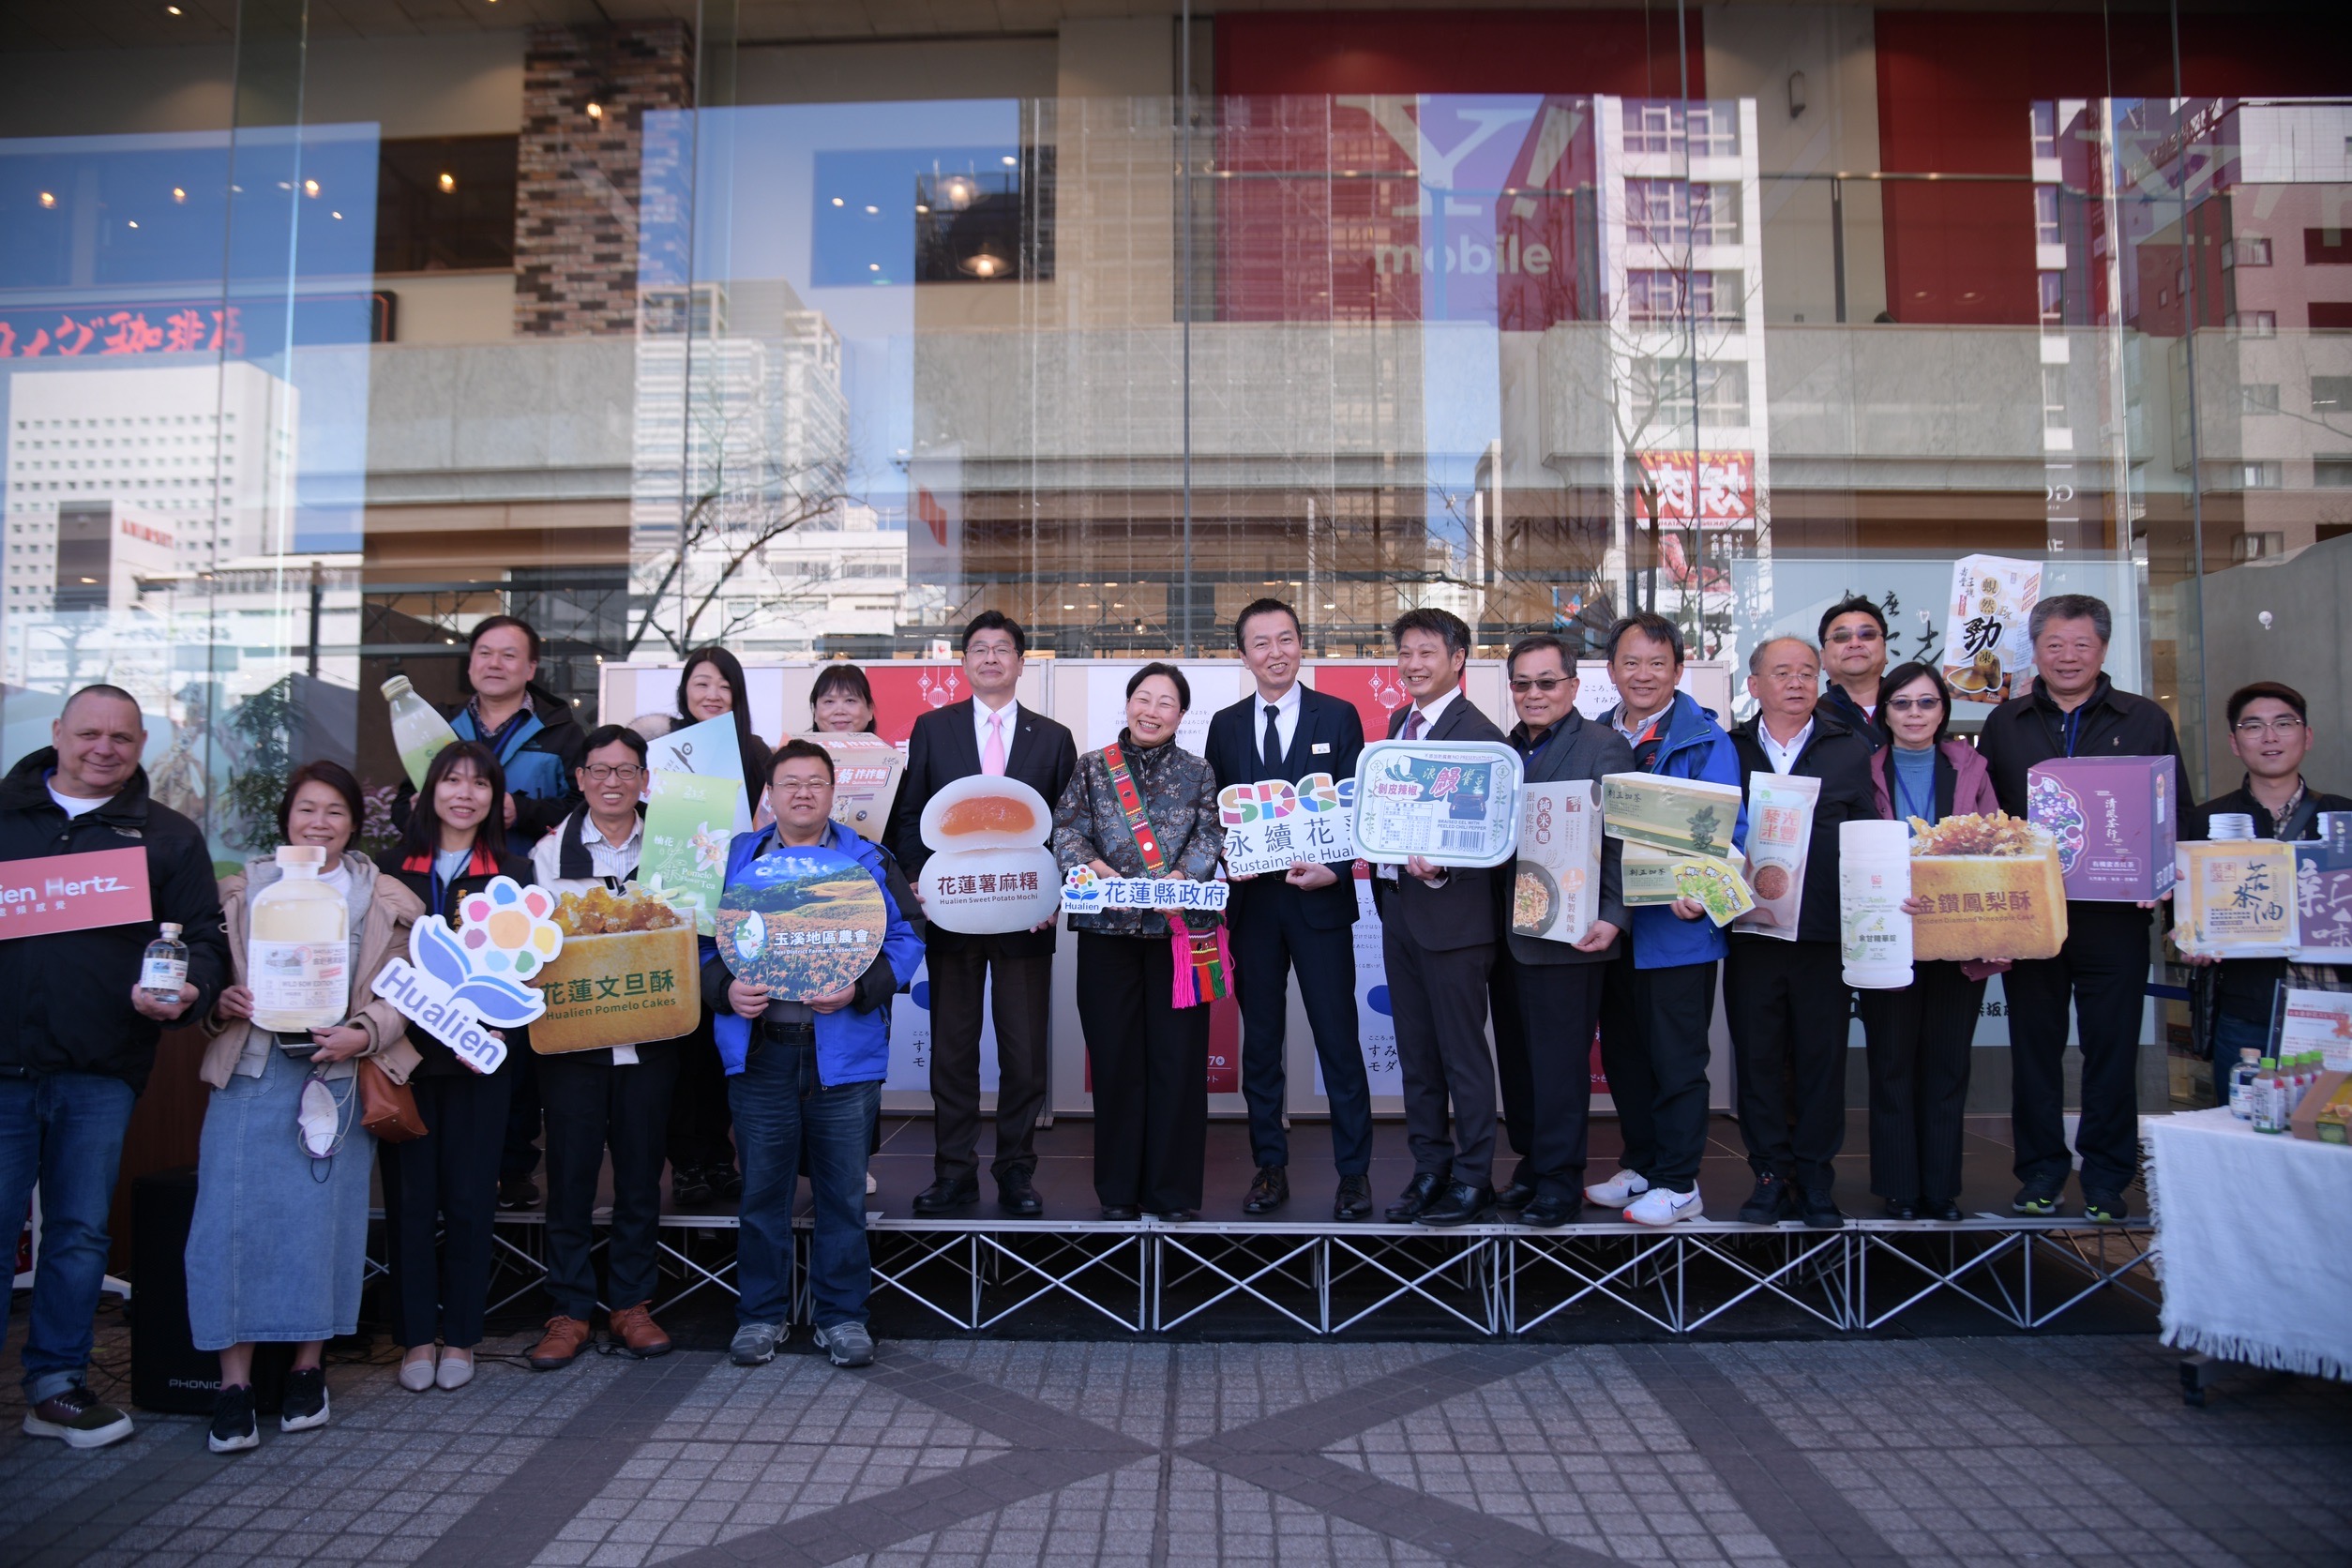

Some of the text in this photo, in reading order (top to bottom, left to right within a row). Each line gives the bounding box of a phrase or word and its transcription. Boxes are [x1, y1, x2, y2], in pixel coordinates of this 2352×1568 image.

[1374, 234, 1552, 275] mobile
[682, 867, 712, 879] Pomelo
[1230, 851, 1316, 874] Sustainable
[45, 876, 135, 897] Hertz
[701, 881, 716, 890] Tea
[937, 871, 1038, 896] 花蓮薯麻糬
[1105, 881, 1226, 907] 花蓮縣政府
[1064, 902, 1099, 911] Hualien
[1919, 890, 2031, 915] 金鑽鳳梨酥
[774, 929, 868, 946] 玉溪地區農會
[540, 969, 674, 1006] 花蓮文旦酥
[380, 965, 500, 1066] Hualien
[546, 997, 676, 1020] Hualien Pomelo Cakes
[1368, 1045, 1397, 1057] すみ
[1368, 1060, 1397, 1073] モダ
[170, 1379, 222, 1390] PHONIC
